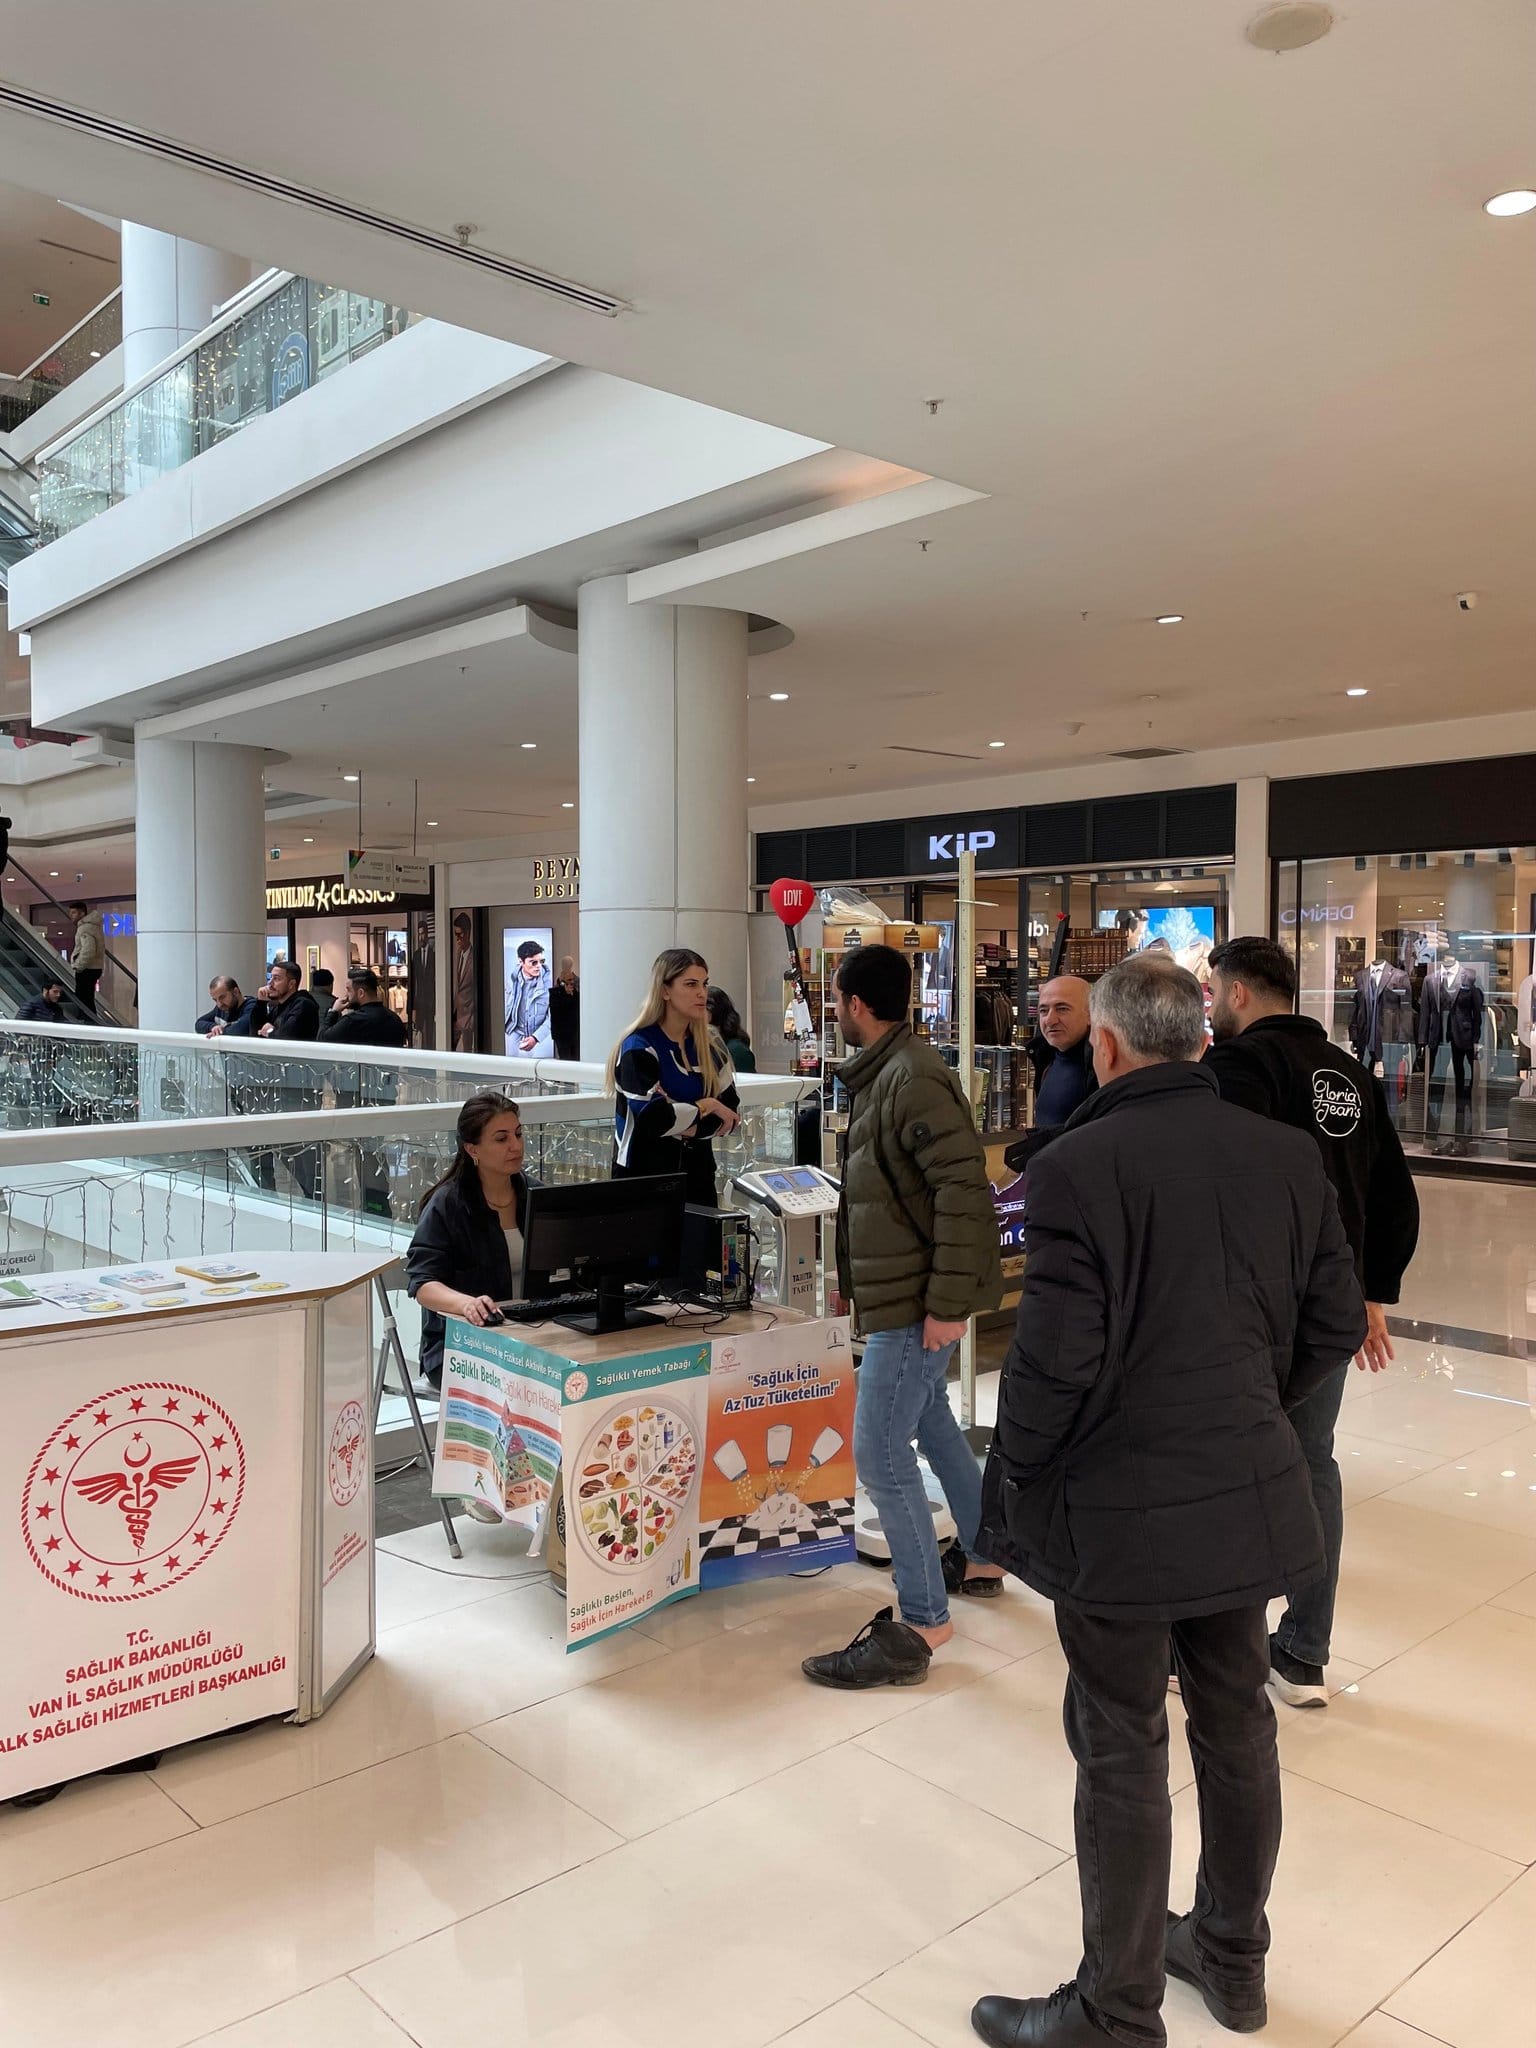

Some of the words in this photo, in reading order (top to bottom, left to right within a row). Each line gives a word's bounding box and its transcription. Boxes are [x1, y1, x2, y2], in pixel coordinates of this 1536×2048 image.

[534, 883, 579, 898] BUSI
[783, 889, 802, 906] LOVE
[1313, 1080, 1356, 1109] Gloria
[1316, 1103, 1361, 1123] Jean's
[450, 1356, 478, 1380] Sağlıklı
[596, 1373, 630, 1386] Sağlıklı
[632, 1367, 662, 1379] Yemek
[664, 1360, 691, 1372] Tabağı
[796, 1364, 819, 1384] İçin
[724, 1399, 741, 1413] Az
[743, 1395, 764, 1409] Tuz
[570, 1598, 602, 1618] Sağlıklı
[604, 1588, 634, 1605] Beslen,
[570, 1614, 597, 1633] Sağlık
[598, 1608, 613, 1622] İçin
[614, 1595, 645, 1614] Hareket
[126, 1628, 154, 1647] T.C.
[65, 1655, 125, 1684] SAĞLIK
[129, 1630, 212, 1667] BAKANLIĞI
[28, 1694, 62, 1719] VAN
[66, 1690, 82, 1708] İL
[85, 1673, 144, 1703] SAĞLIK
[147, 1643, 243, 1686] MÜDÜRLÜĞÜ
[32, 1710, 98, 1744] SAĞLIĞI
[103, 1682, 195, 1724] HİZMETLERİ
[198, 1655, 286, 1695] BAŞKANLIĞI
